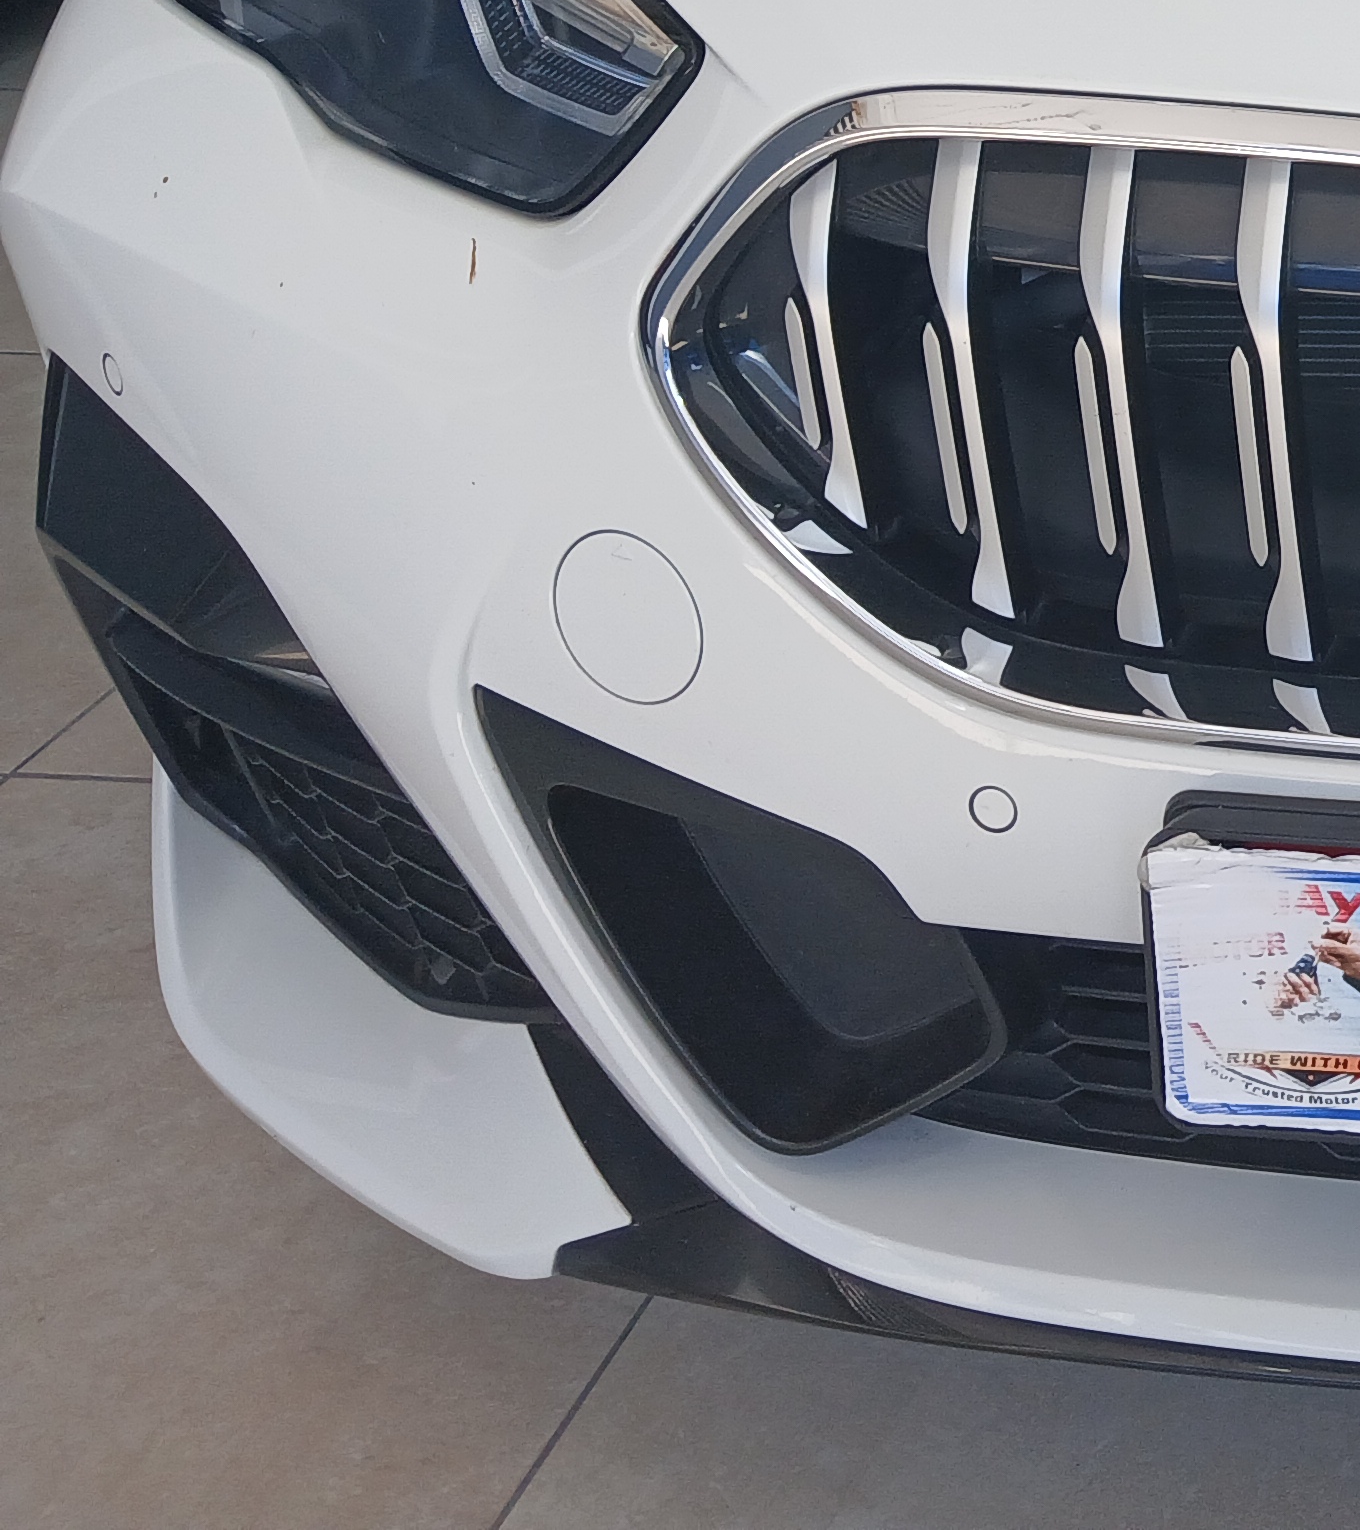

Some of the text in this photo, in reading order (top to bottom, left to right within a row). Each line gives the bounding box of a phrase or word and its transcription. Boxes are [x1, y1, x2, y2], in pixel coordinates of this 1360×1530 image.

[1226, 1053, 1282, 1066] RIDE
[1290, 1054, 1349, 1070] WITH
[1241, 1079, 1304, 1104] Trusted
[1308, 1093, 1359, 1105] Motor
